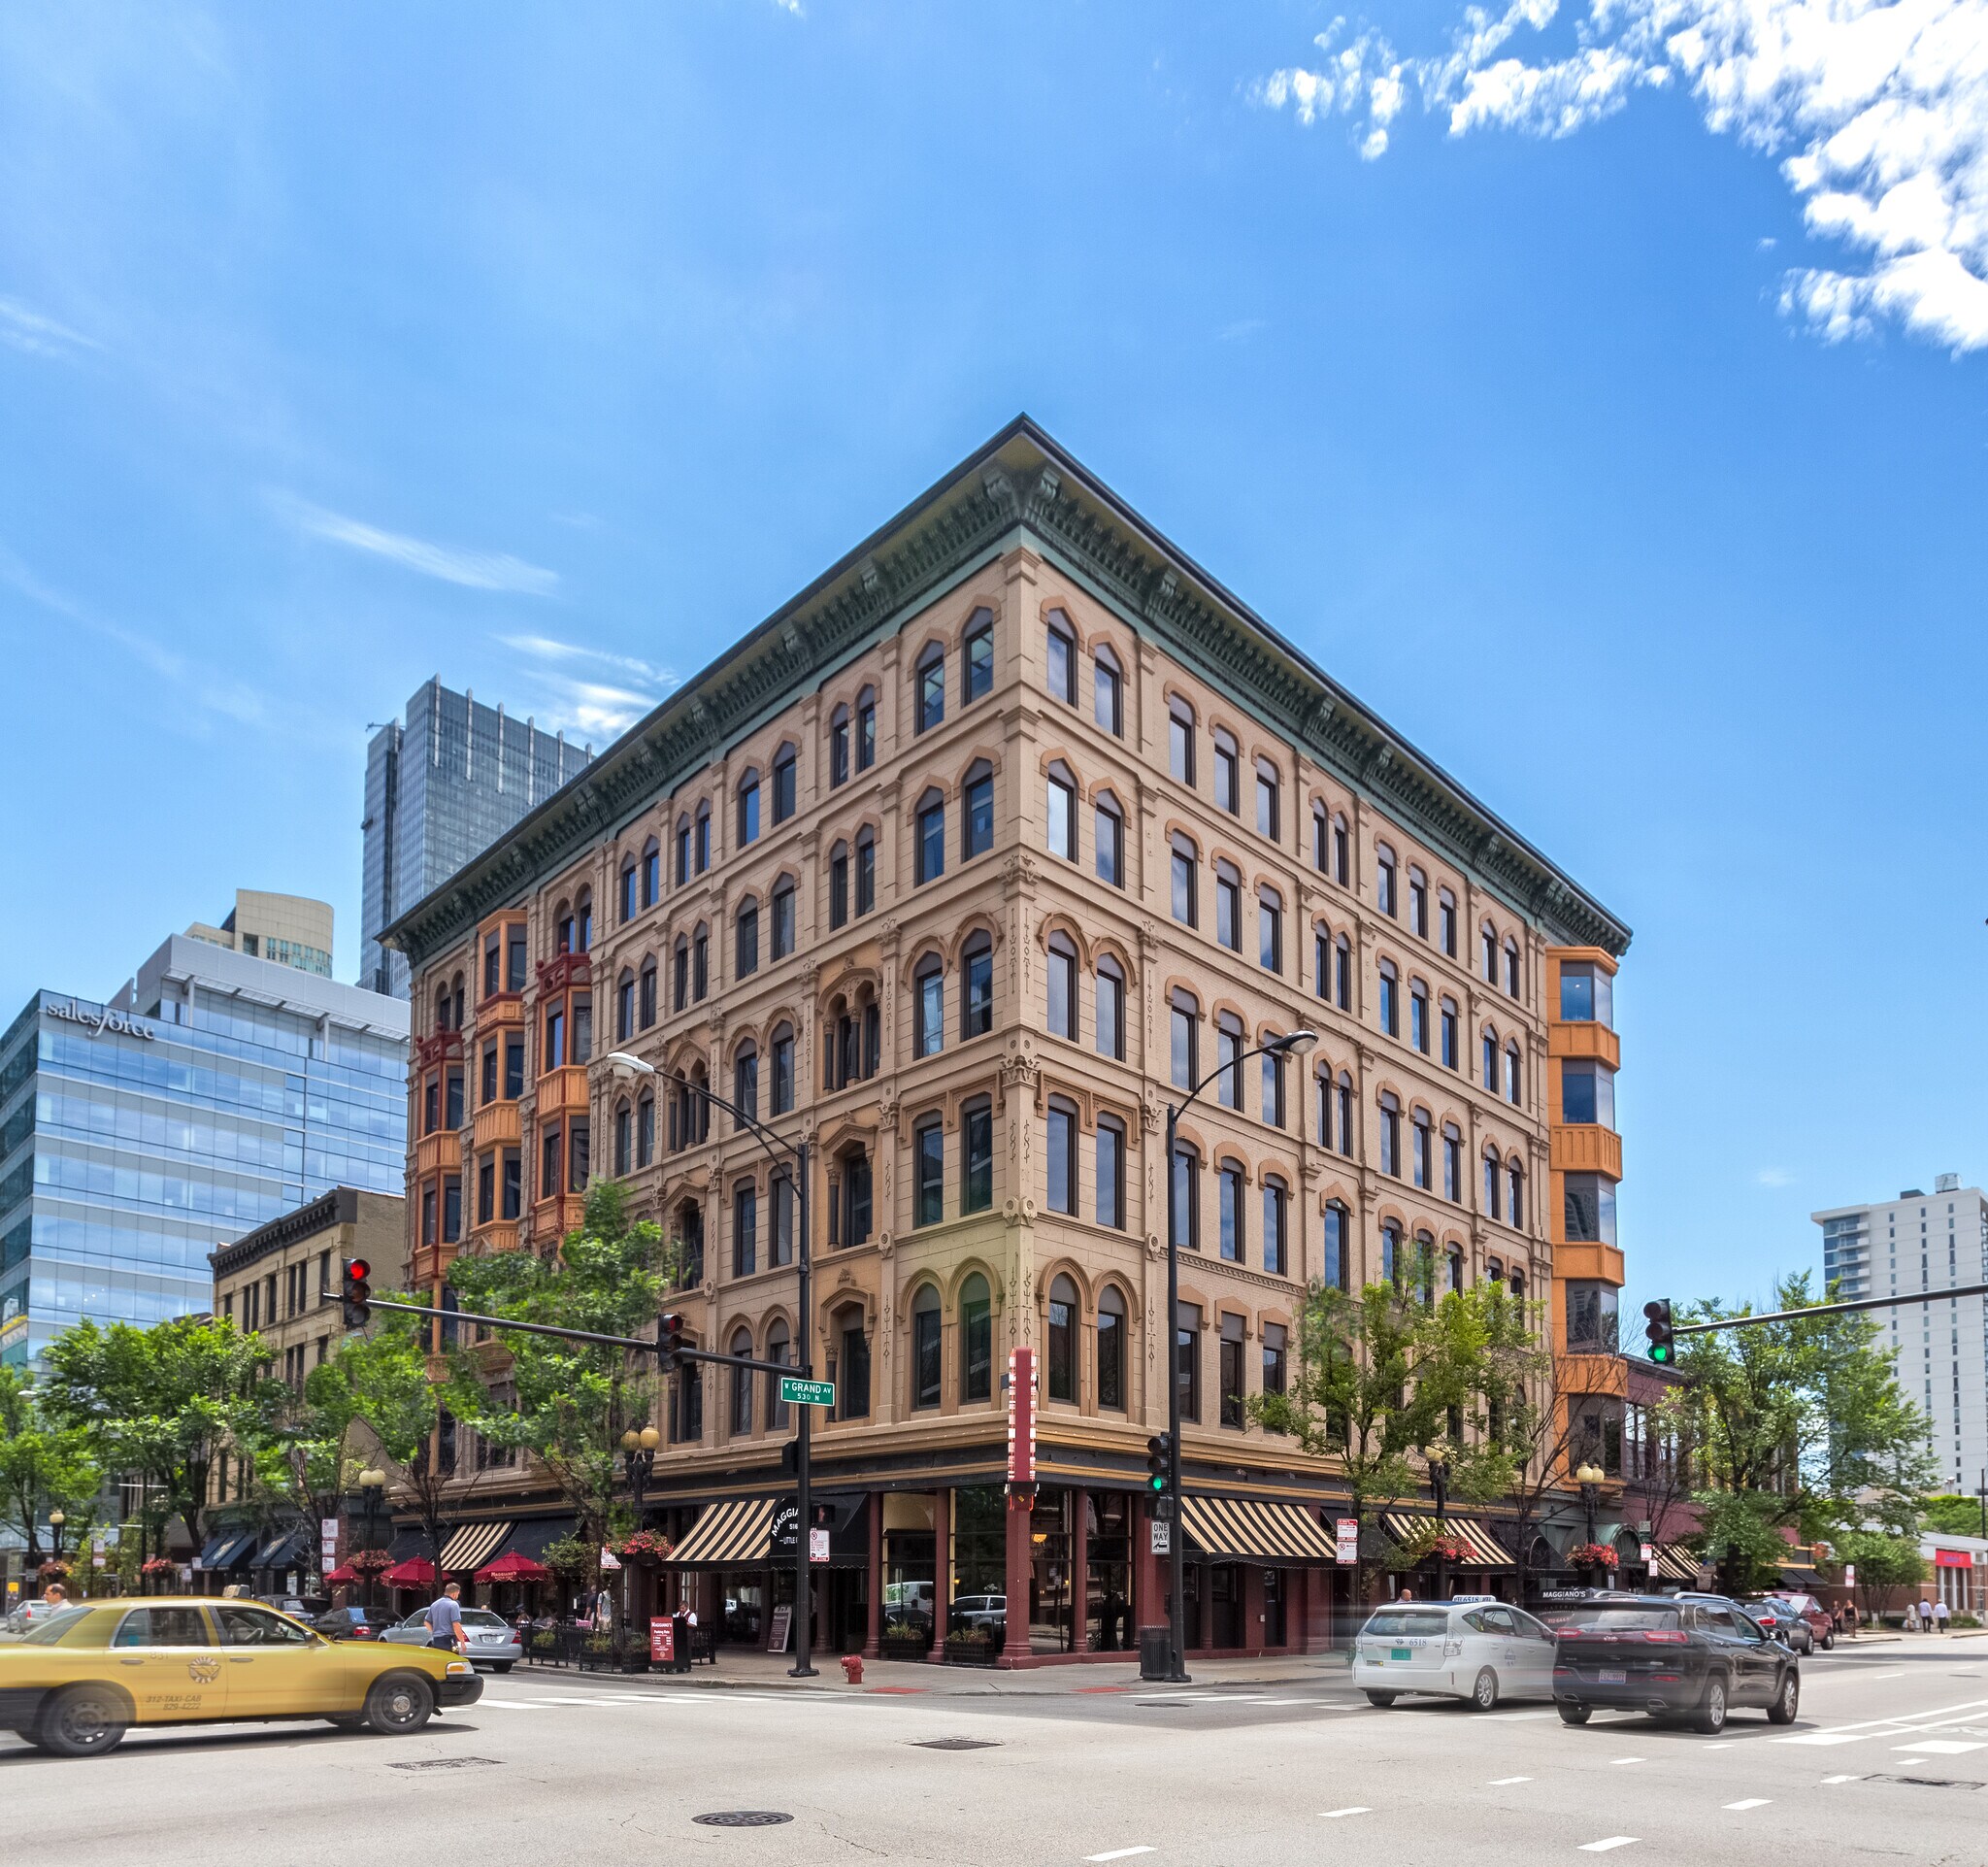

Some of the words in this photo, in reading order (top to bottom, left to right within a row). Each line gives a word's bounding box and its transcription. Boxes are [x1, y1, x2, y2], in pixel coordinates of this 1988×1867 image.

[47, 998, 155, 1040] salesforce
[792, 1383, 820, 1393] GRAND
[1153, 1523, 1168, 1532] ONE
[1153, 1532, 1168, 1541] WAY
[1408, 1638, 1427, 1647] 6518
